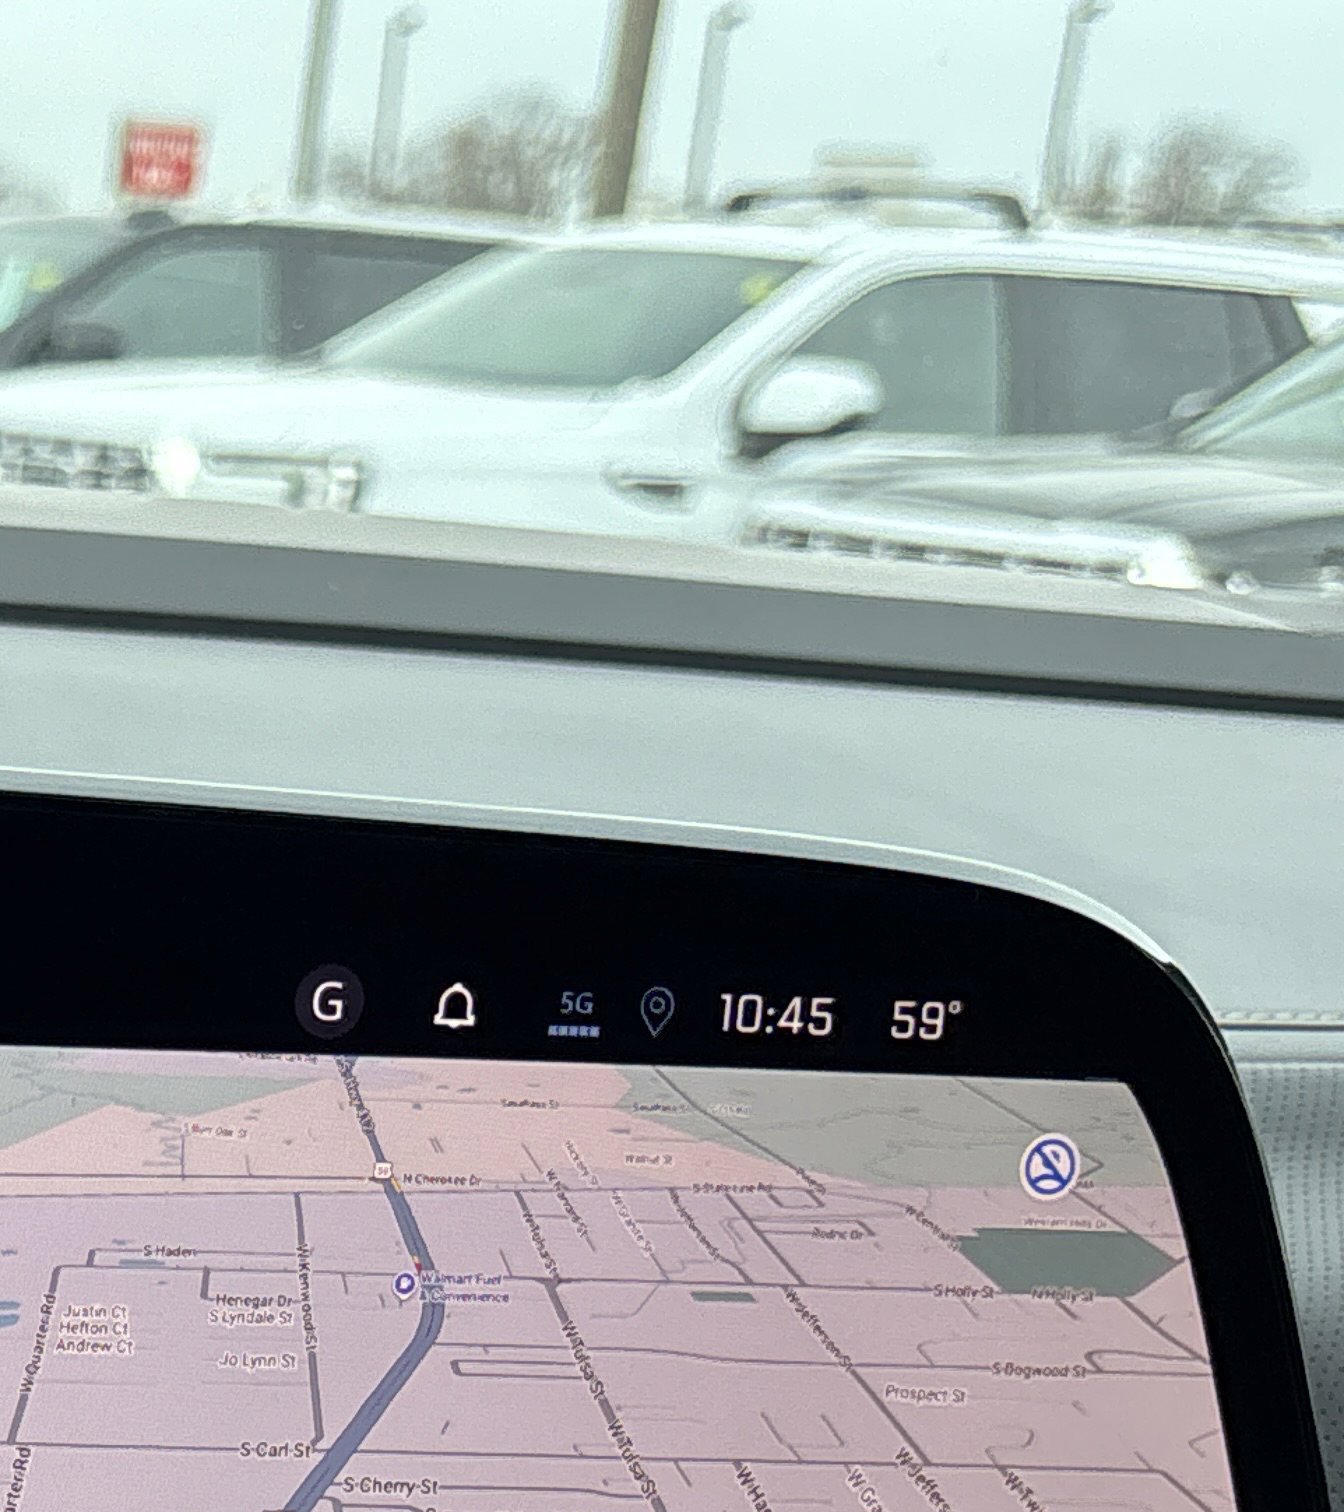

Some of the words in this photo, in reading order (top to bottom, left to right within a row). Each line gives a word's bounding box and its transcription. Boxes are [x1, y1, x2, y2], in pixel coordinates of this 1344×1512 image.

[312, 982, 344, 1022] G
[560, 992, 593, 1014] 5G
[720, 993, 834, 1037] 10:45
[891, 1001, 963, 1040] 59°
[476, 1275, 502, 1286] Fuel
[216, 1294, 274, 1310] Henegar
[277, 1295, 293, 1308] Dr
[62, 1304, 106, 1319] Justin
[112, 1305, 127, 1320] Ct
[209, 1311, 218, 1323] S
[222, 1310, 275, 1327] Lyndale
[279, 1311, 293, 1324] St
[59, 1321, 108, 1336] Hefton
[112, 1322, 128, 1337] Ct
[56, 1339, 112, 1354] Andrew
[116, 1340, 133, 1355] Ct
[219, 1354, 238, 1367] Jo
[243, 1354, 277, 1370] Lynn
[281, 1356, 295, 1369] St
[993, 1364, 1001, 1375] S
[1004, 1363, 1068, 1380] Dogwood
[1072, 1365, 1086, 1377] St
[886, 1385, 947, 1402] Prospect
[953, 1388, 965, 1402] St
[12, 1446, 31, 1473] Rd
[895, 1446, 912, 1467] W
[736, 1465, 753, 1485] W
[846, 1468, 866, 1489] W
[1005, 1473, 1022, 1492] W
[343, 1478, 355, 1493] S
[360, 1478, 415, 1498] Cherry
[421, 1479, 438, 1495] St
